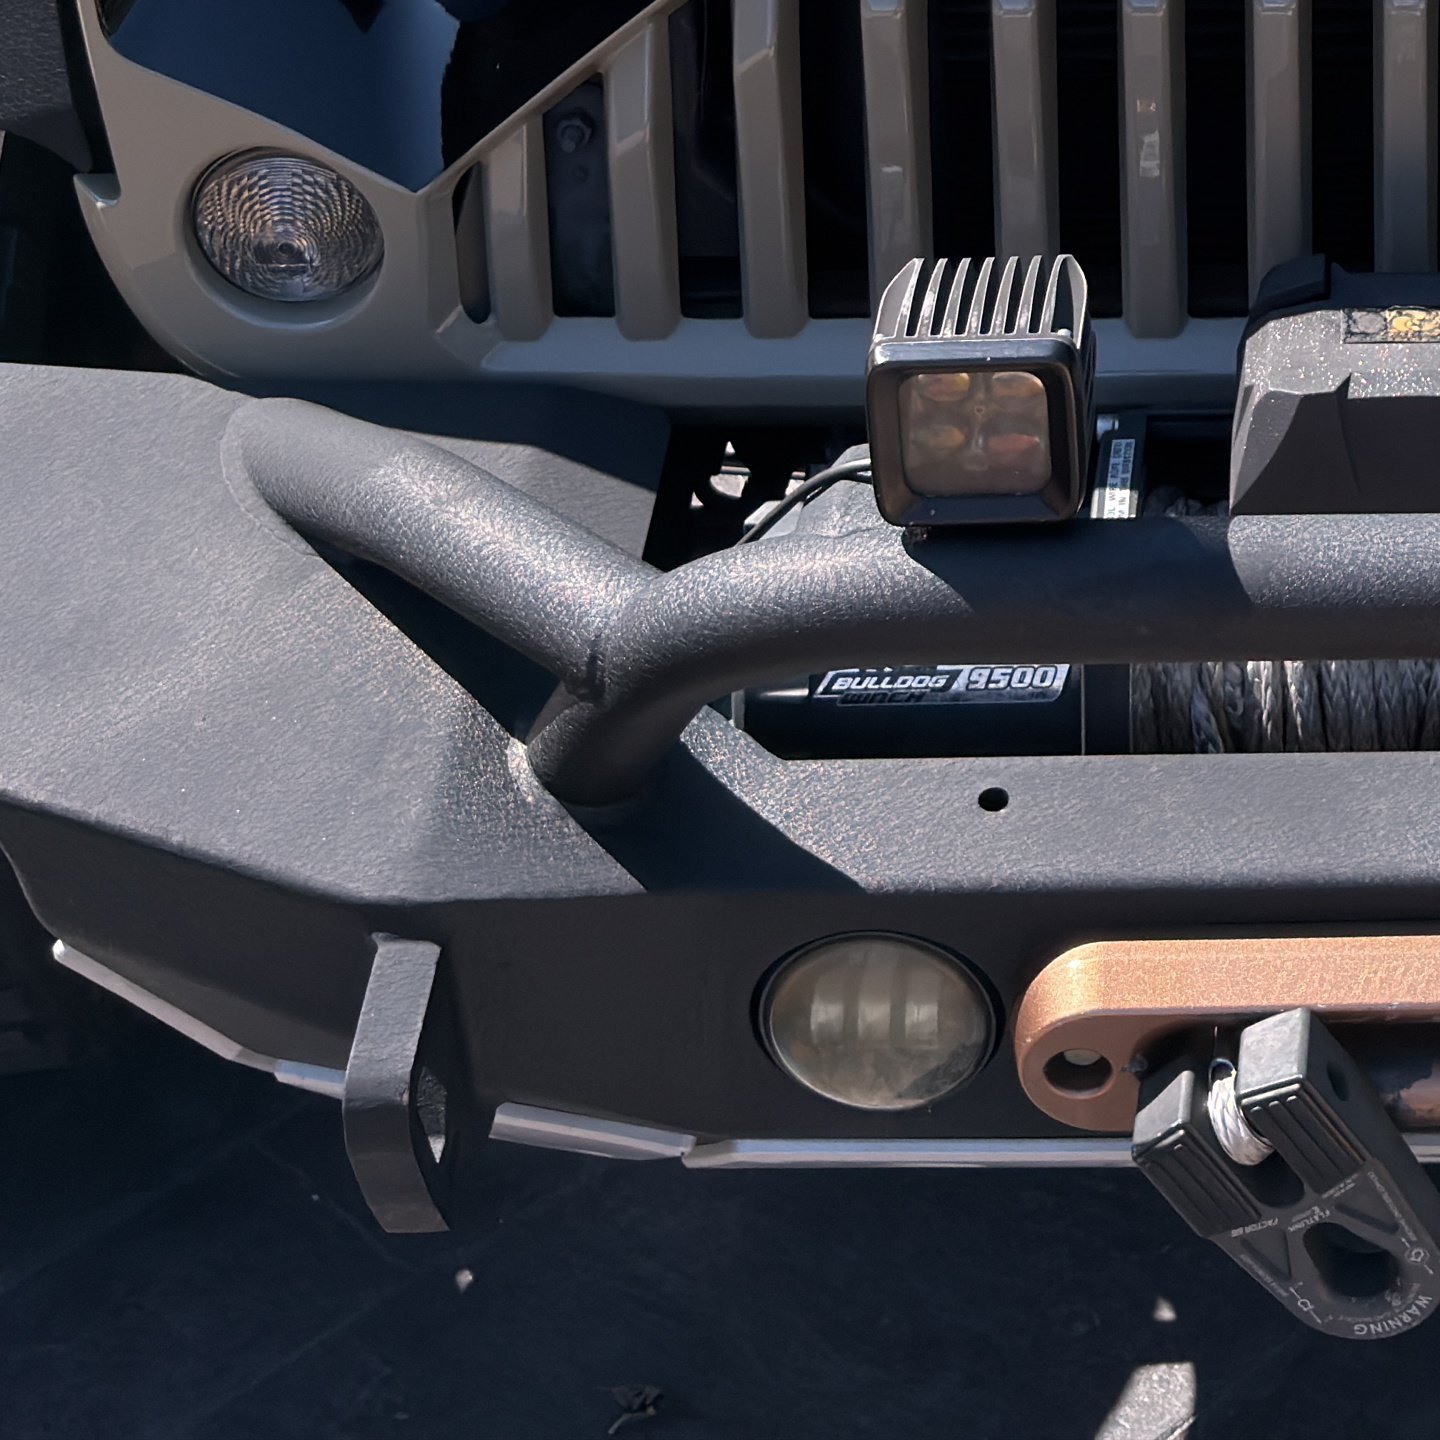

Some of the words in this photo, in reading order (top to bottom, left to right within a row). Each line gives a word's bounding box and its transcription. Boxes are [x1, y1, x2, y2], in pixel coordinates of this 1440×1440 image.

[832, 674, 950, 690] BULLDOG
[967, 666, 1059, 691] 9500
[1353, 1294, 1433, 1335] WARNING
